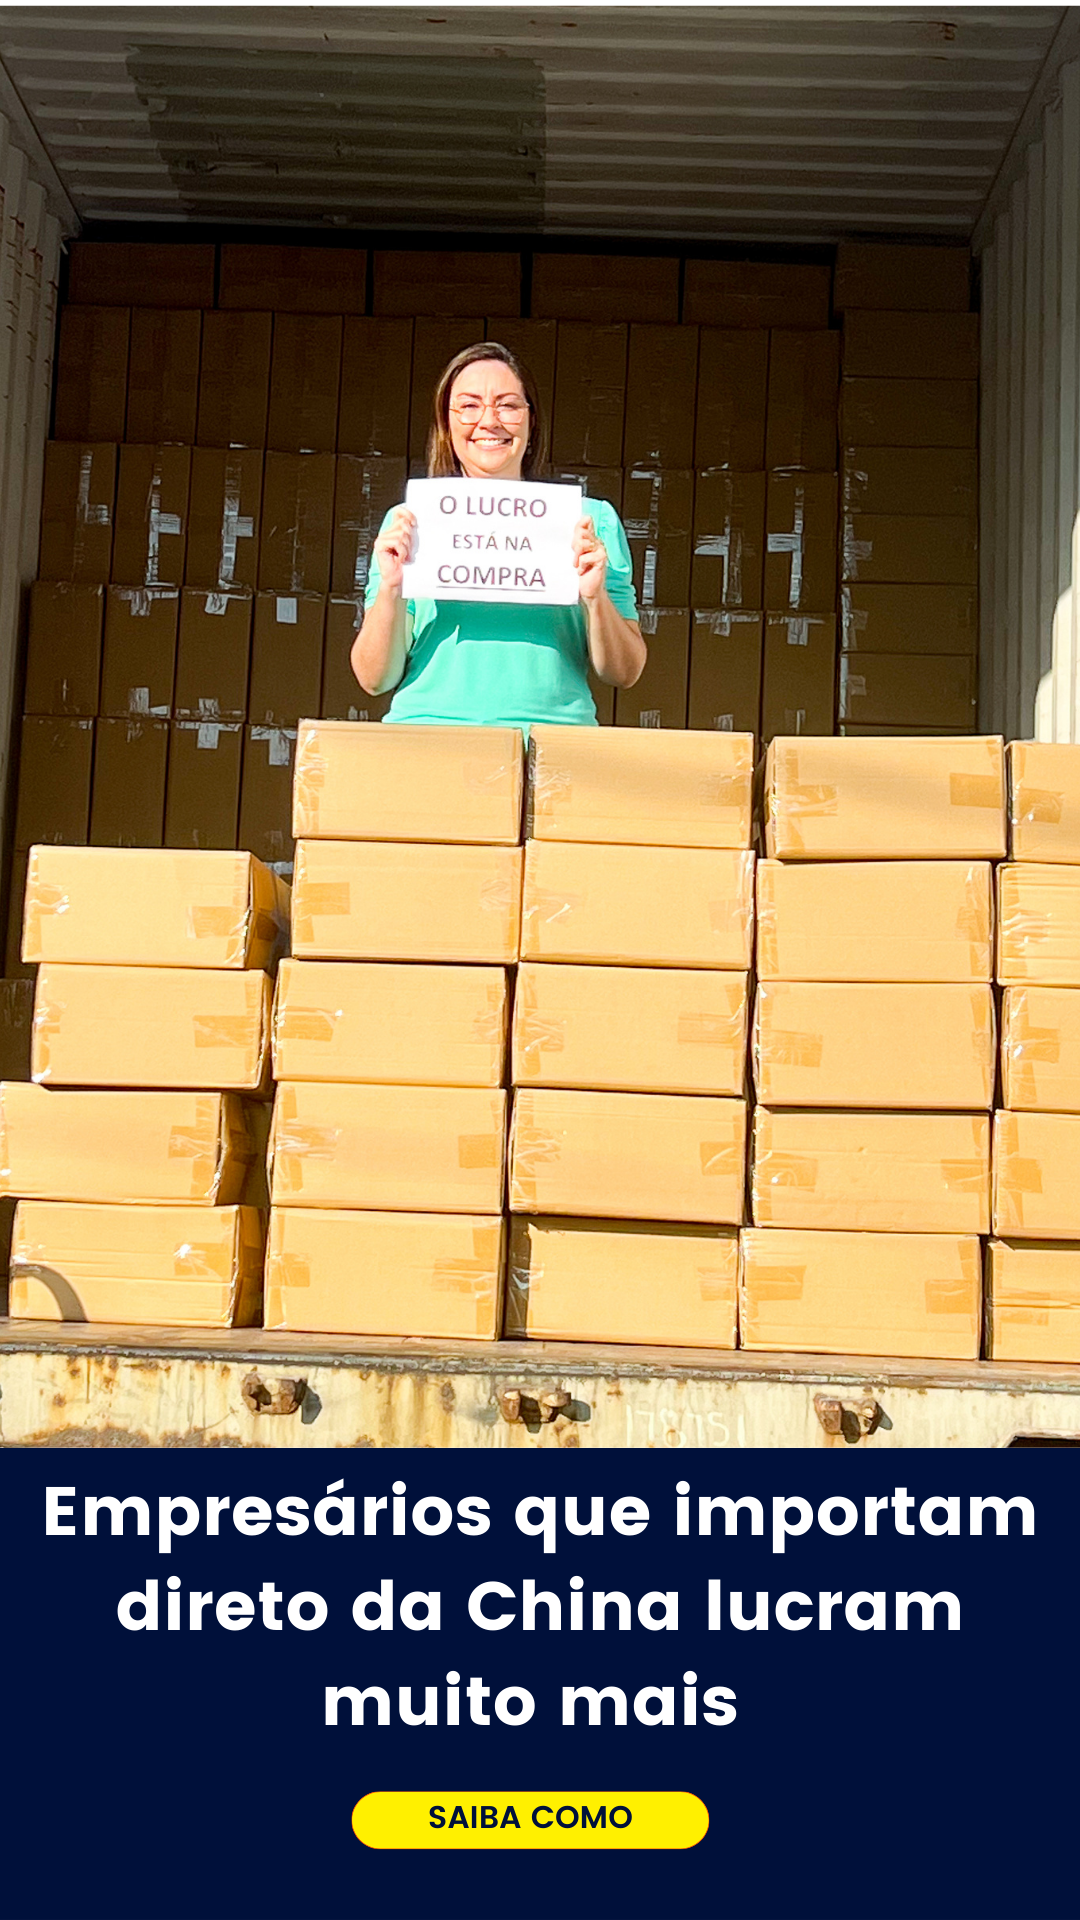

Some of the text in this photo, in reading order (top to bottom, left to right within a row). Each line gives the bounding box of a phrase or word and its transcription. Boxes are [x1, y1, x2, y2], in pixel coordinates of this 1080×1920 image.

[439, 495, 547, 518] O LUCRO
[452, 532, 532, 552] ESTÁ NA
[437, 564, 546, 587] COMPRA
